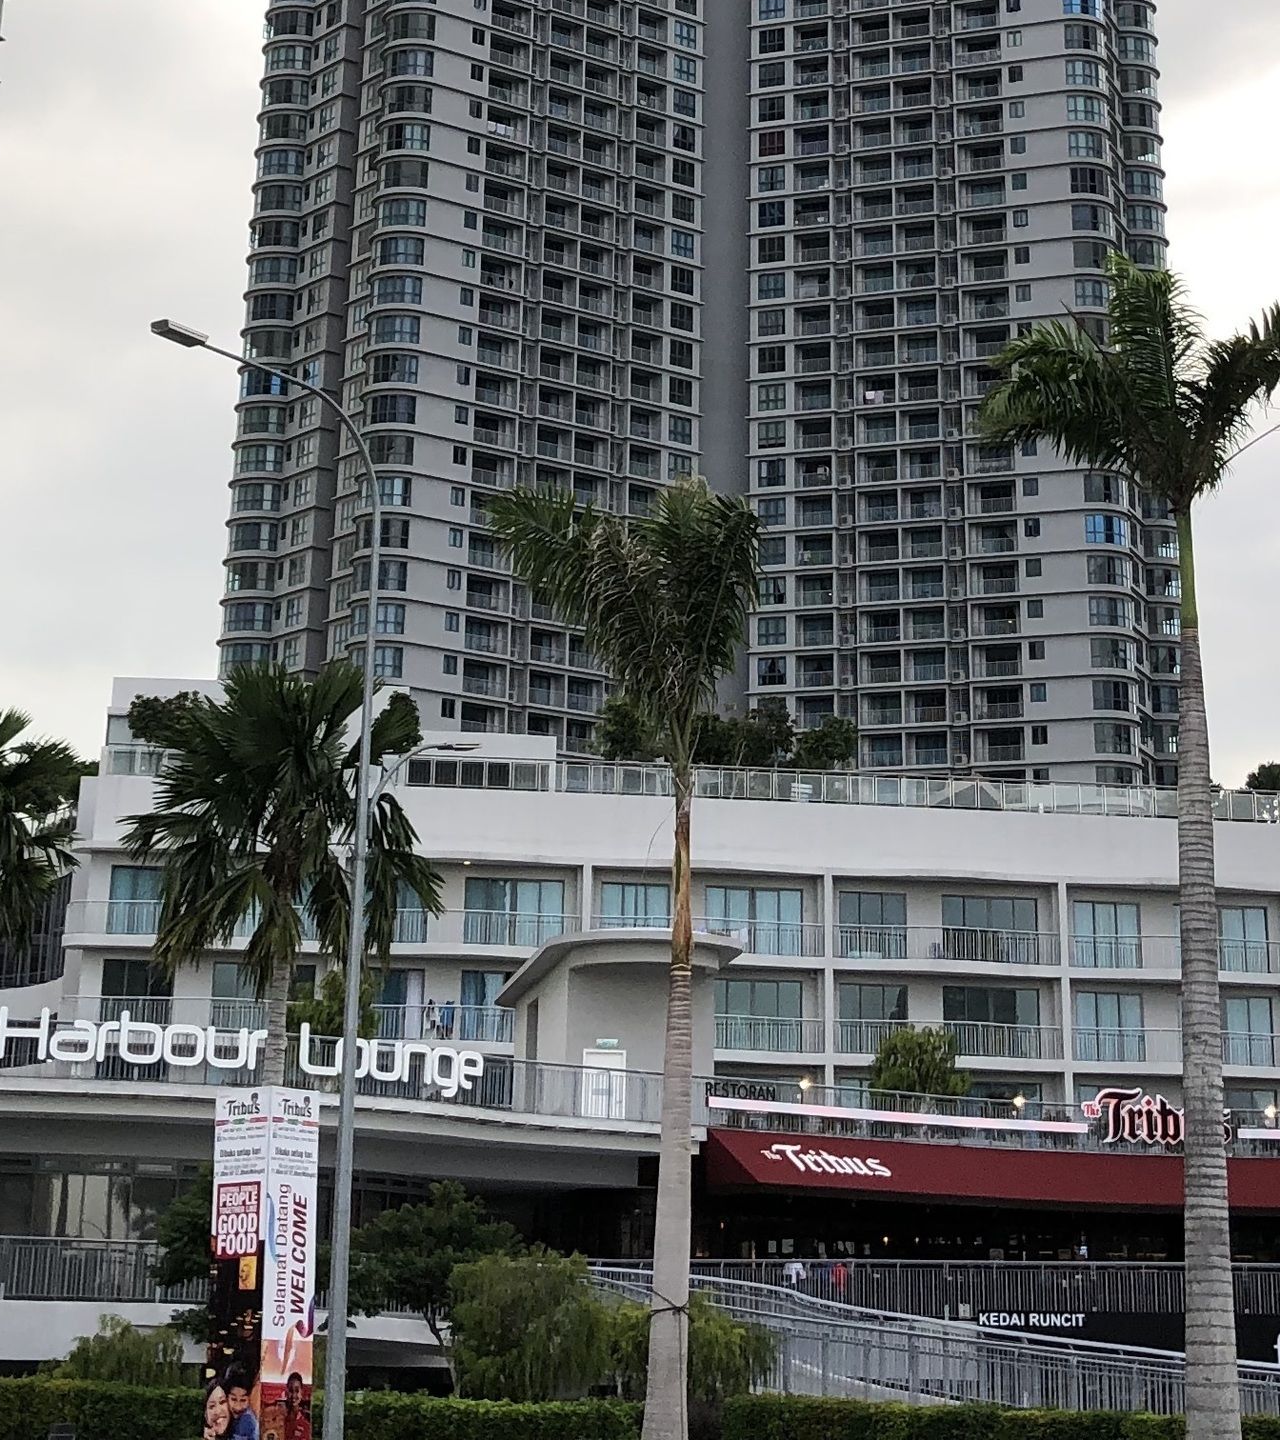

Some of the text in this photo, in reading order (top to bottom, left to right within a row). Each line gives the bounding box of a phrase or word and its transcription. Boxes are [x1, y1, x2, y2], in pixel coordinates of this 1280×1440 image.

[300, 1022, 484, 1097] Lounge
[705, 1081, 776, 1101] RESTORAN
[220, 1191, 258, 1207] PEOPLE
[218, 1213, 257, 1233] GOOD
[217, 1232, 257, 1255] FOOD
[290, 1193, 307, 1314] WELCOME
[273, 1184, 292, 1327] Selamat Datang
[979, 1313, 1085, 1327] KEDAI RUNCIT
